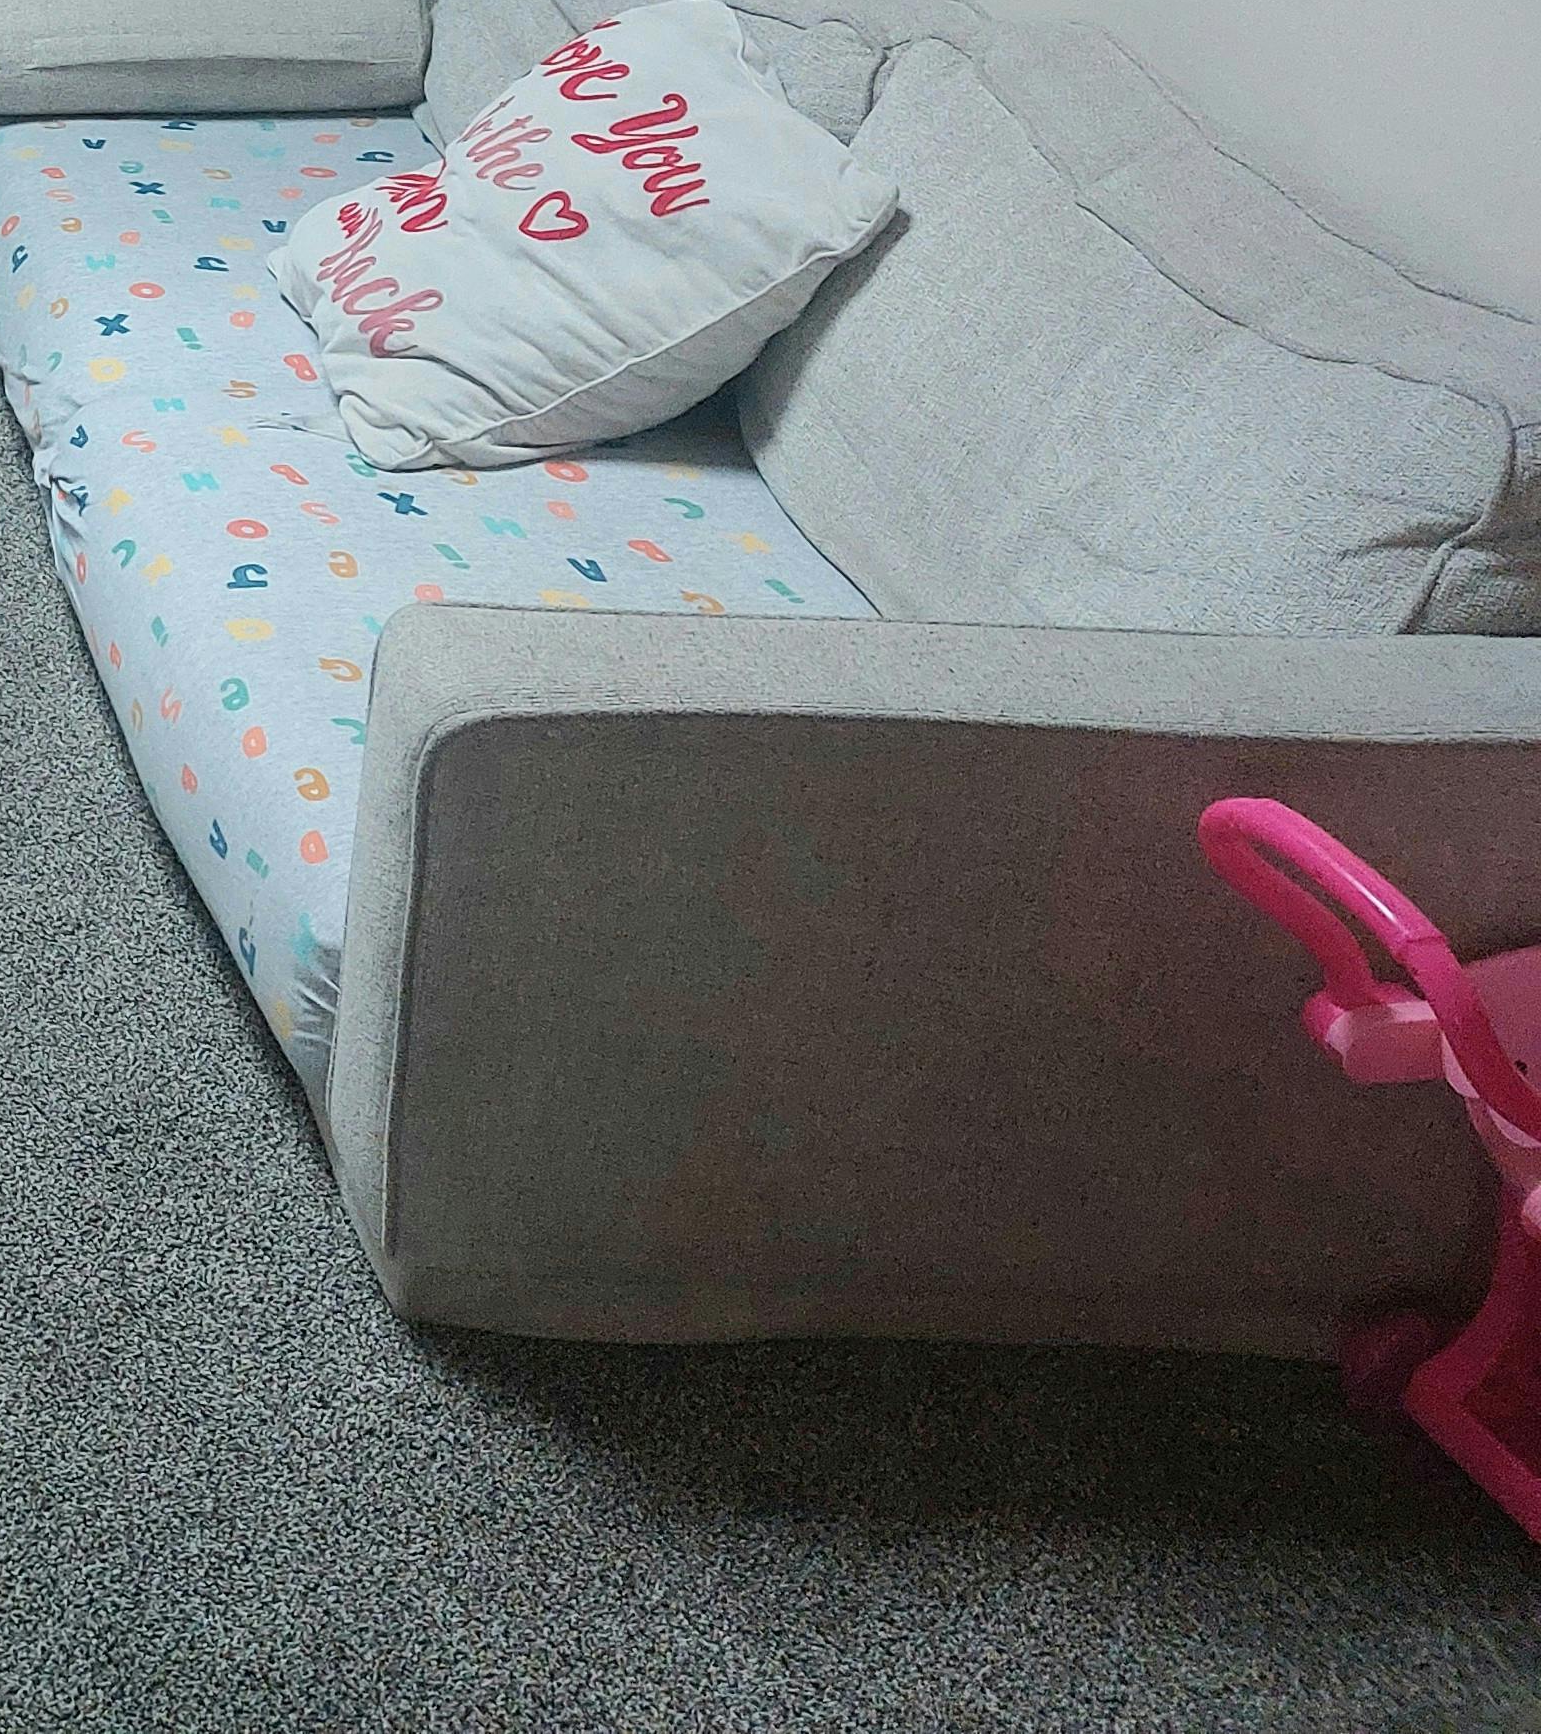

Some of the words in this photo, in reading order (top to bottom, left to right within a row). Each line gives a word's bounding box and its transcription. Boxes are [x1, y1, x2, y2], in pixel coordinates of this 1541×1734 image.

[541, 18, 630, 102] ove
[466, 114, 553, 190] the
[571, 93, 710, 217] You
